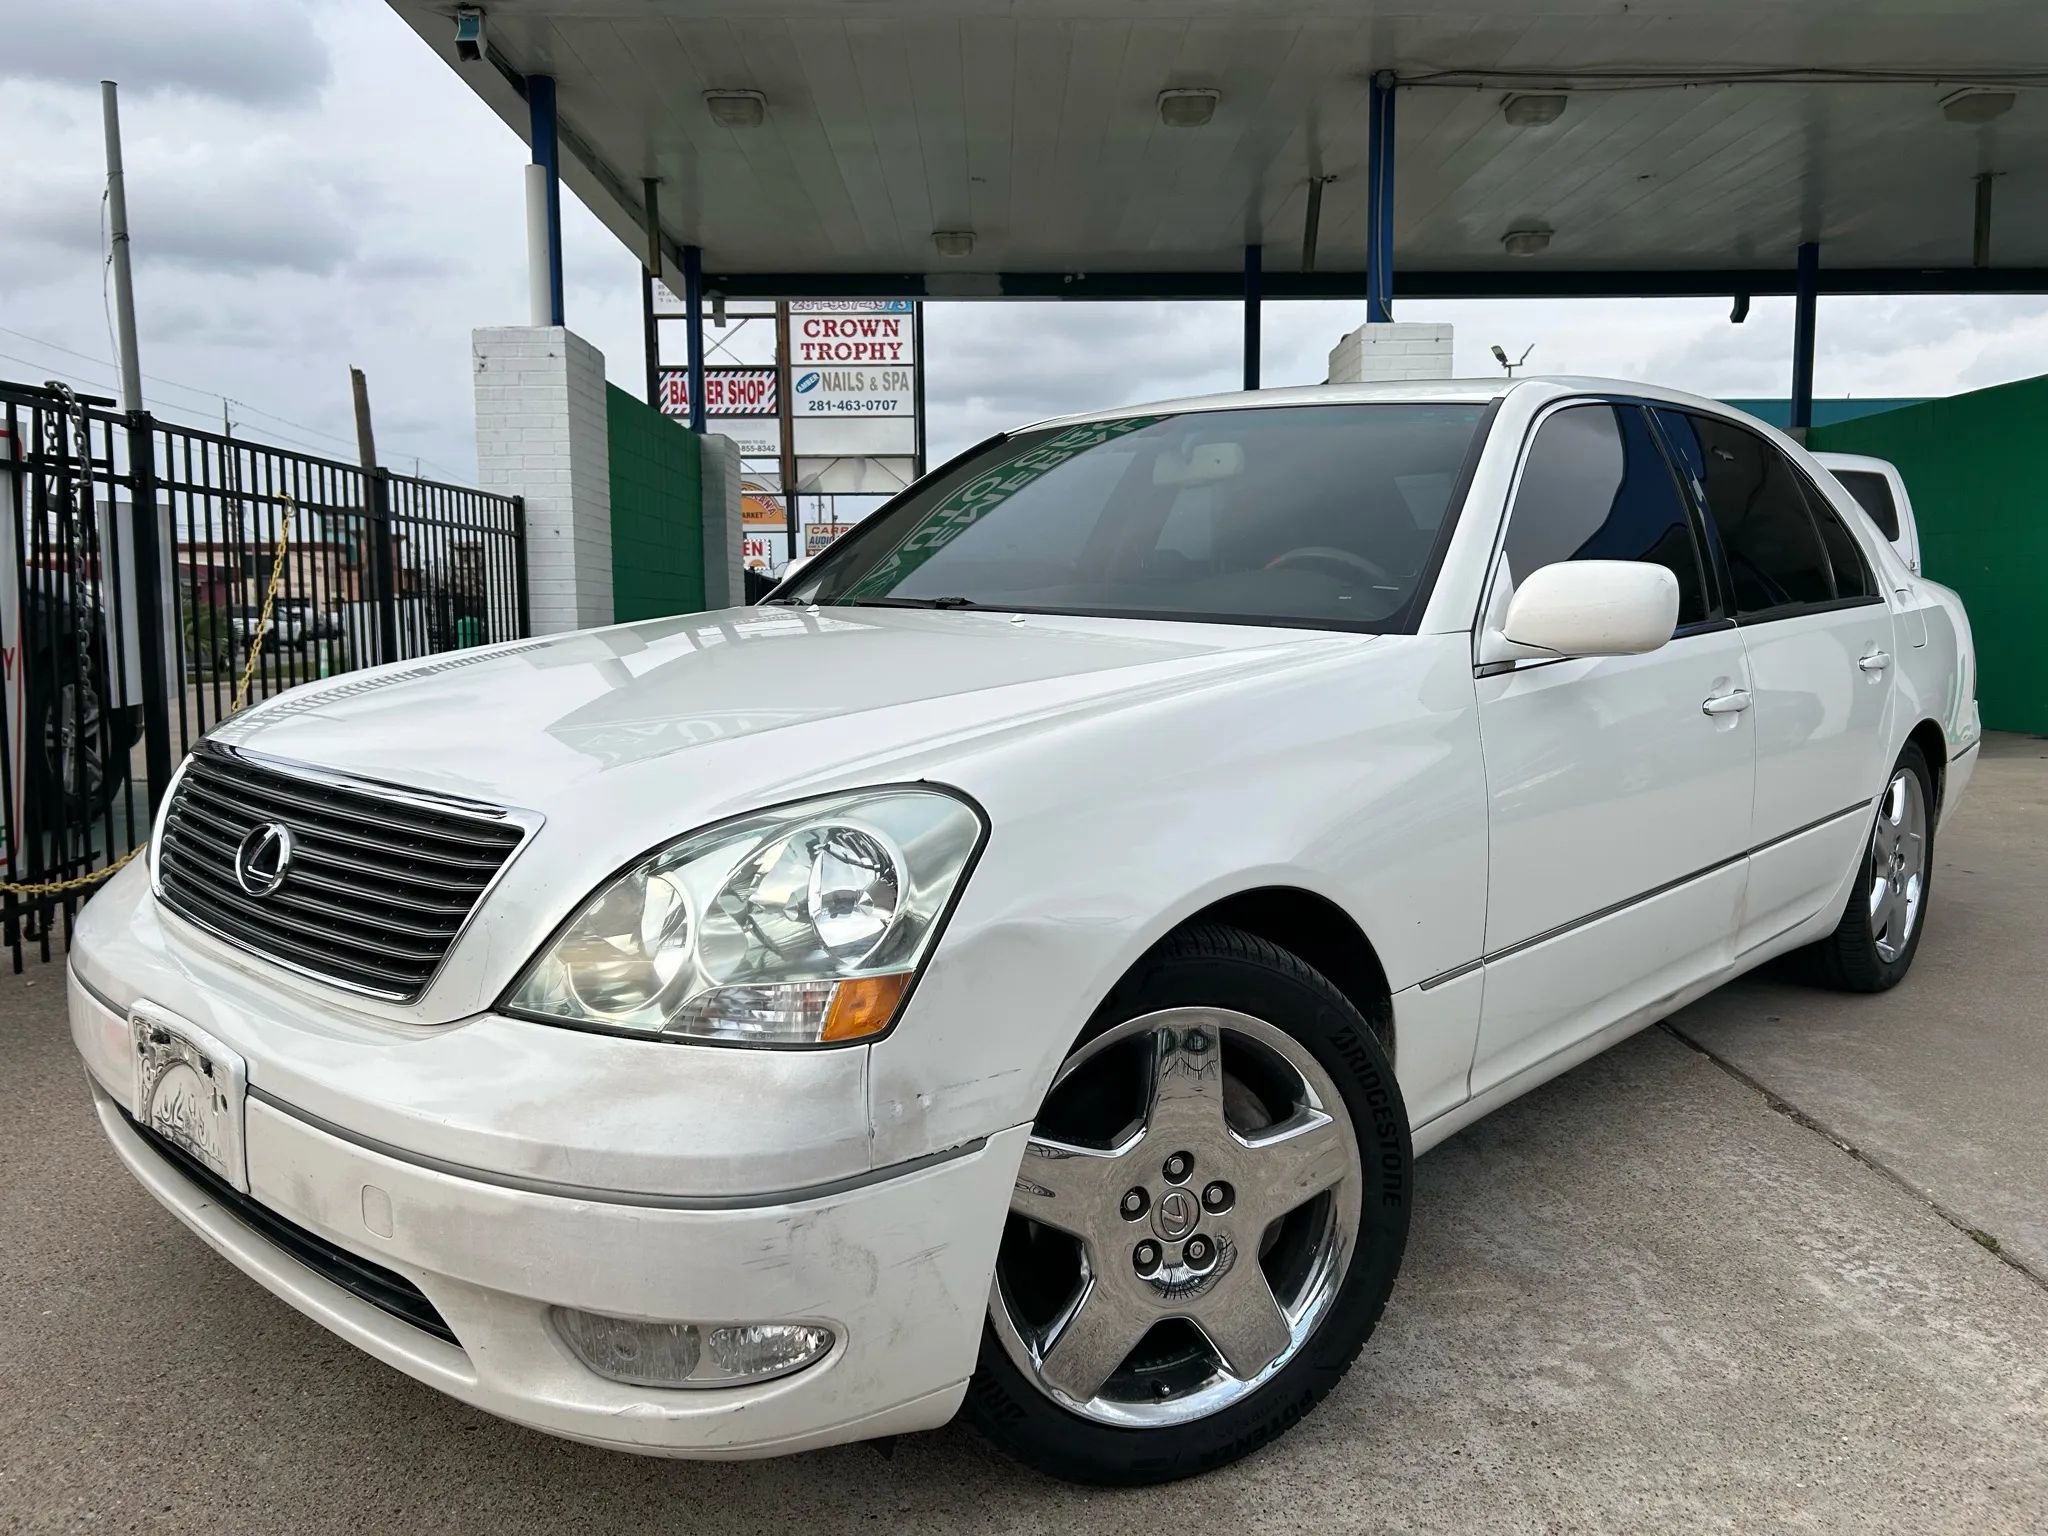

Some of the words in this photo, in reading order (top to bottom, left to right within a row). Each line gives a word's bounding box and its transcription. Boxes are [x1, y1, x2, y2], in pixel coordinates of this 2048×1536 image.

[803, 319, 901, 338] CROWN
[800, 342, 904, 361] TROPHY
[821, 371, 864, 392] NAILS
[869, 377, 879, 392] &
[882, 371, 910, 392] SPA
[670, 380, 723, 405] BAER
[728, 380, 766, 405] SHOP
[808, 399, 898, 412] 281-463-0707
[1328, 1024, 1404, 1209] BRIDGESTONE
